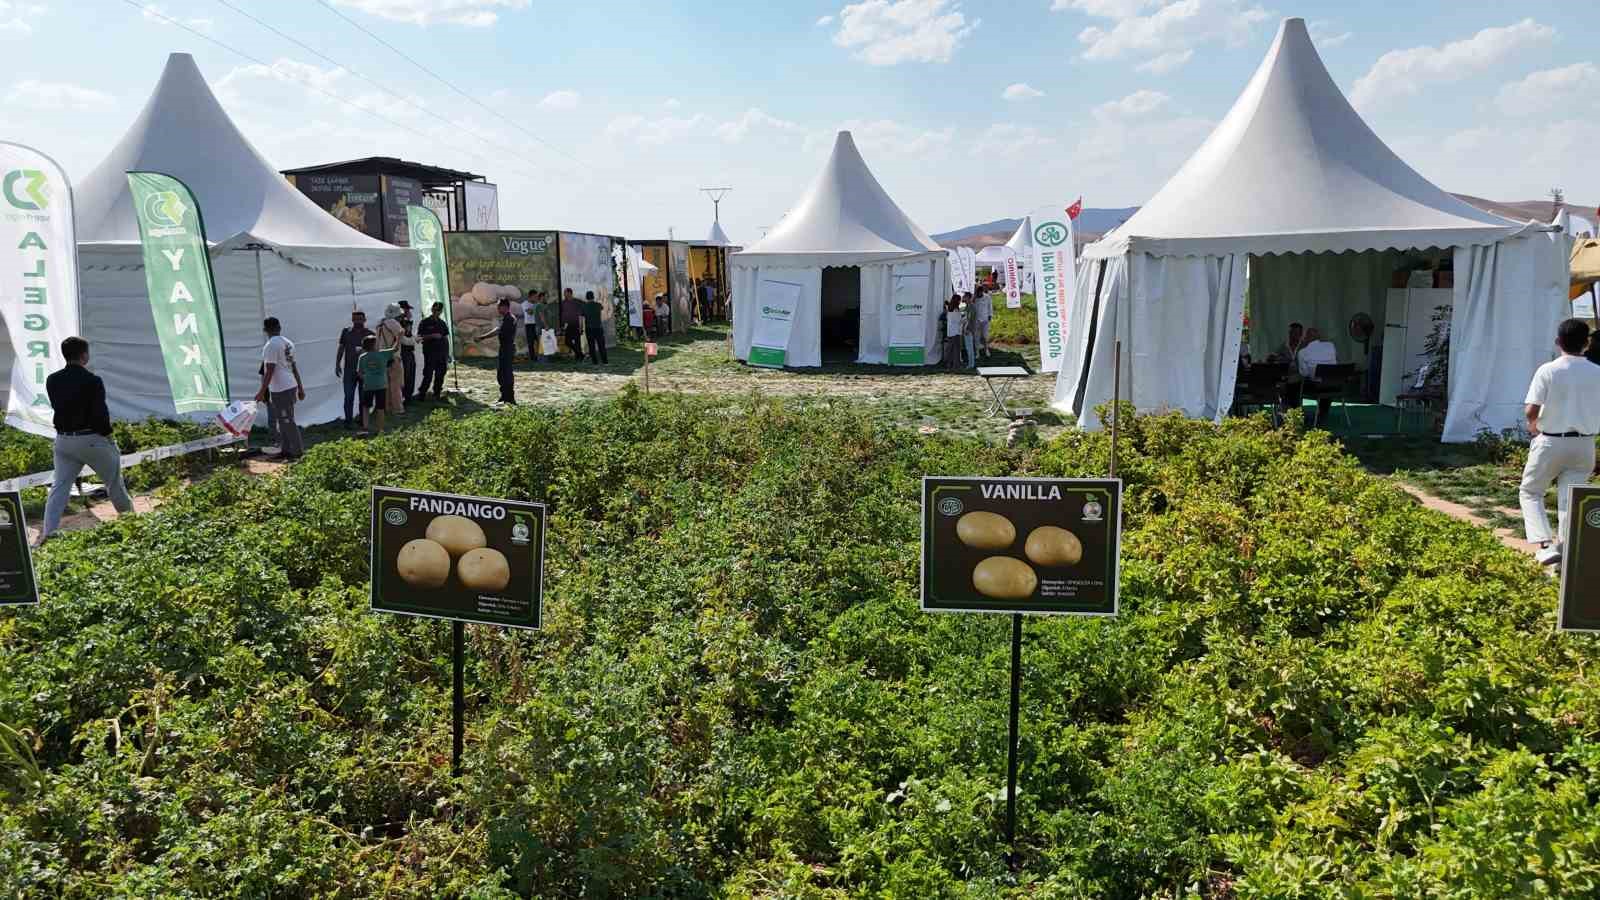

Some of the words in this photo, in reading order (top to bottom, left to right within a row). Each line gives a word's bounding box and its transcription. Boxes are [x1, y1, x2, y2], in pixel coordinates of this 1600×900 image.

[502, 237, 546, 254] Vogue
[980, 484, 1062, 500] VANILLA
[409, 497, 506, 520] FANDANGO
